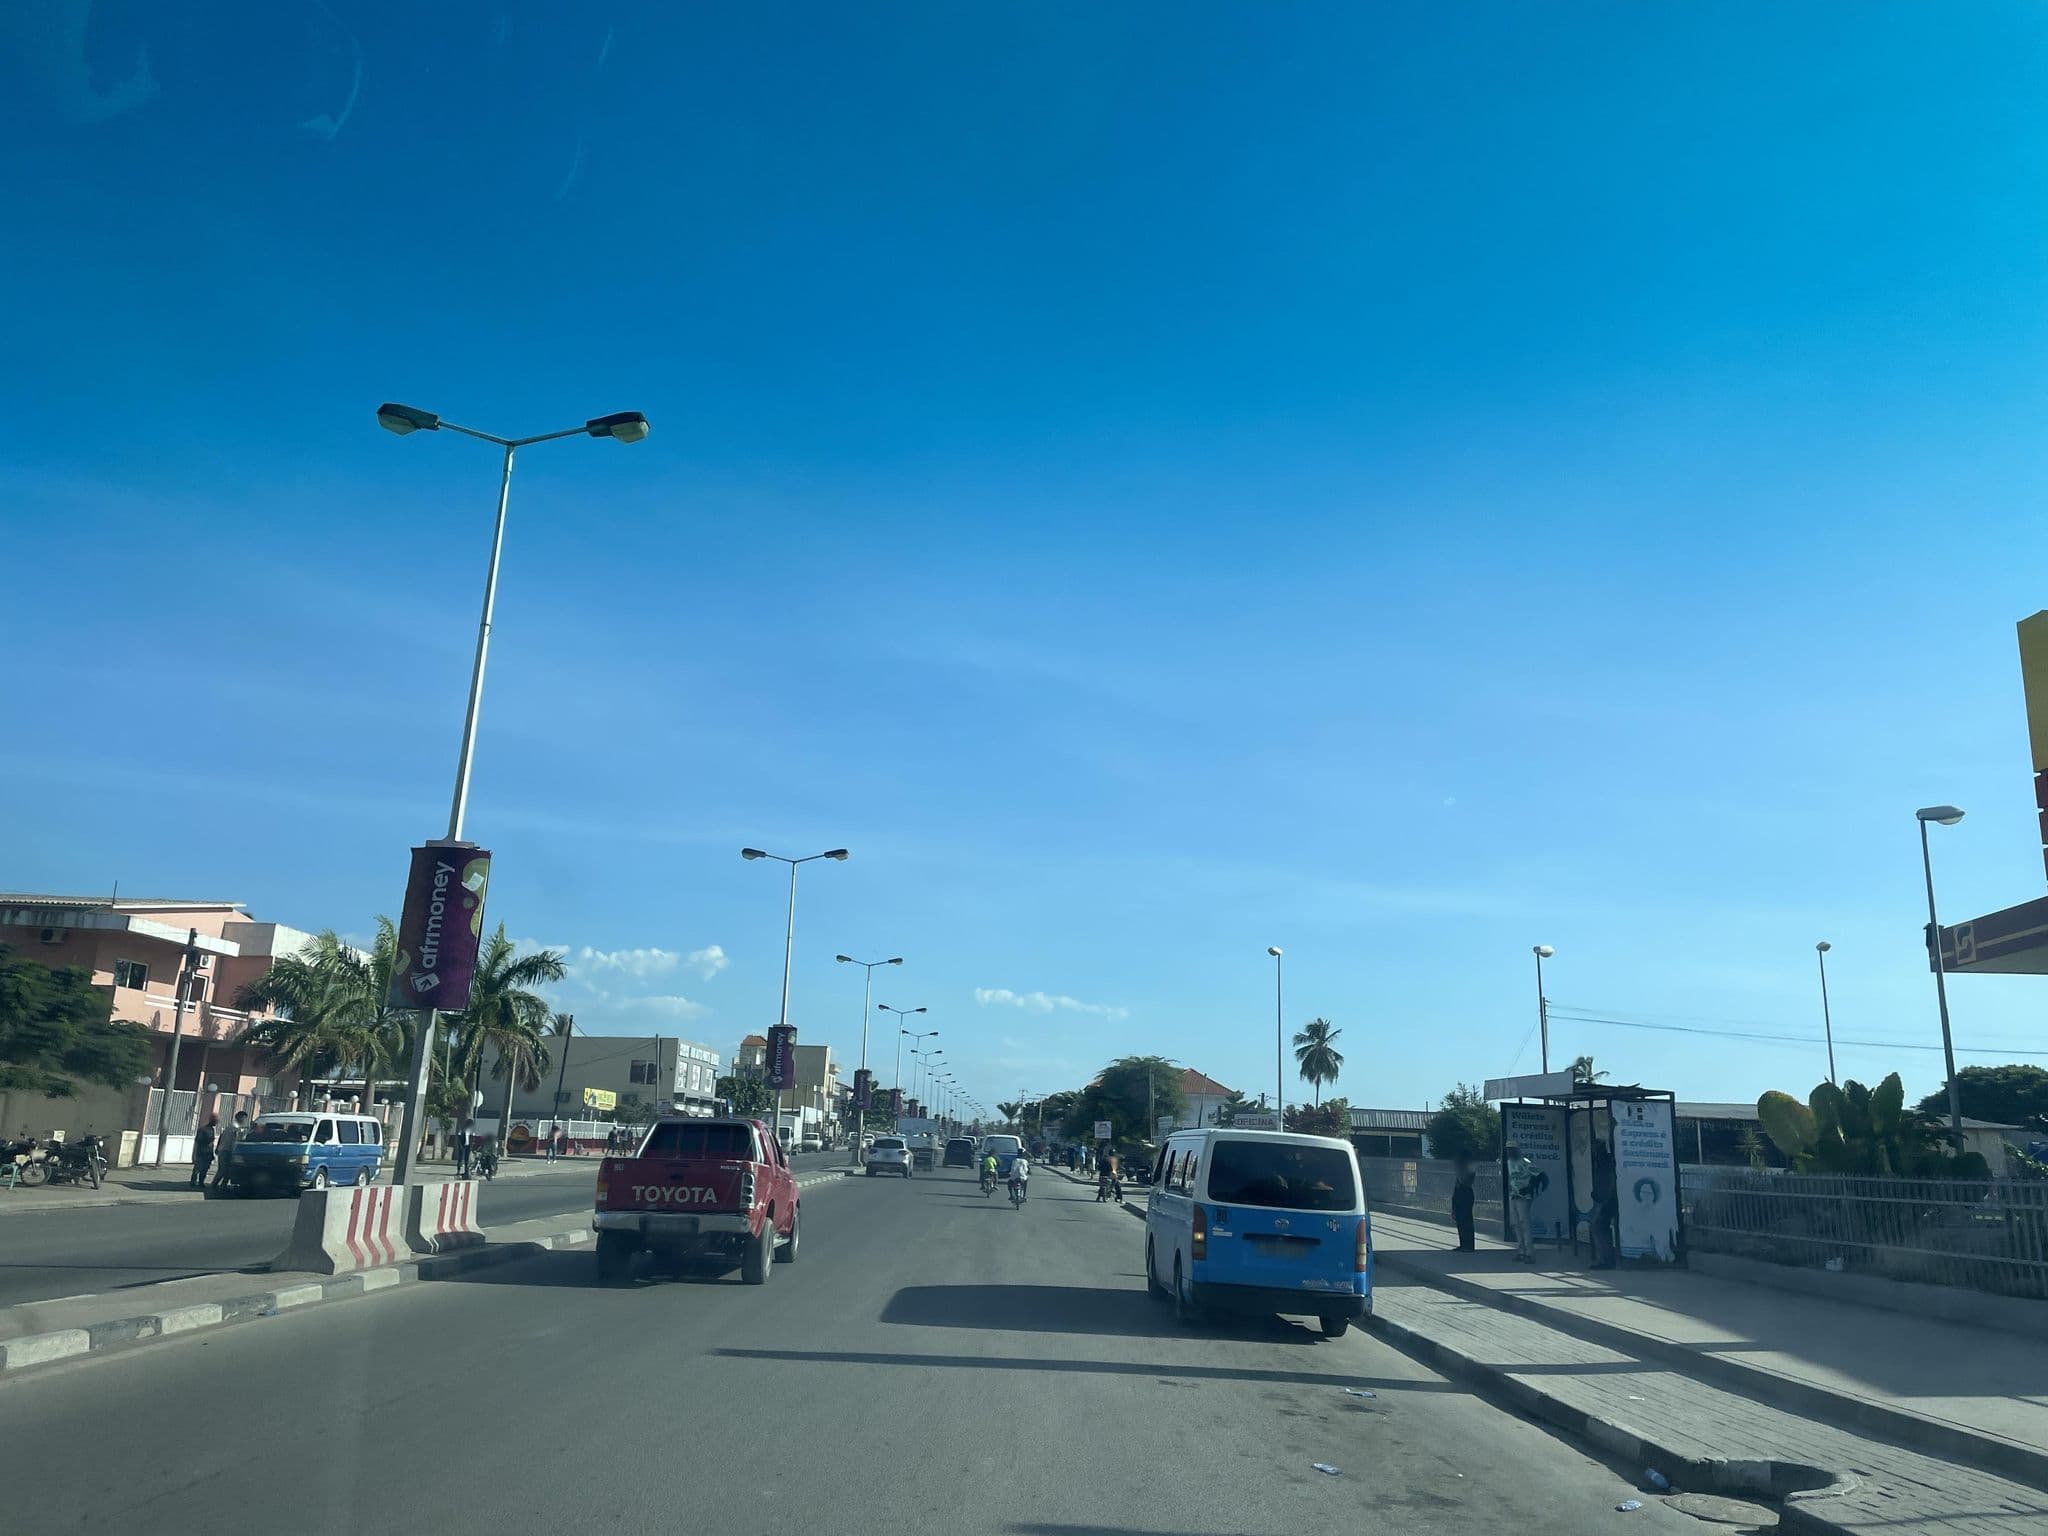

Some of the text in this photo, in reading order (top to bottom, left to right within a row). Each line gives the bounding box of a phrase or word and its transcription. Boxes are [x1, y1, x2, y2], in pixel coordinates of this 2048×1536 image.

[419, 861, 455, 968] afrimoney
[1512, 1121, 1549, 1130] Express
[1520, 1131, 1554, 1140] crédito
[1519, 1142, 1560, 1150] estinado
[632, 1186, 717, 1203] TOYOTA
